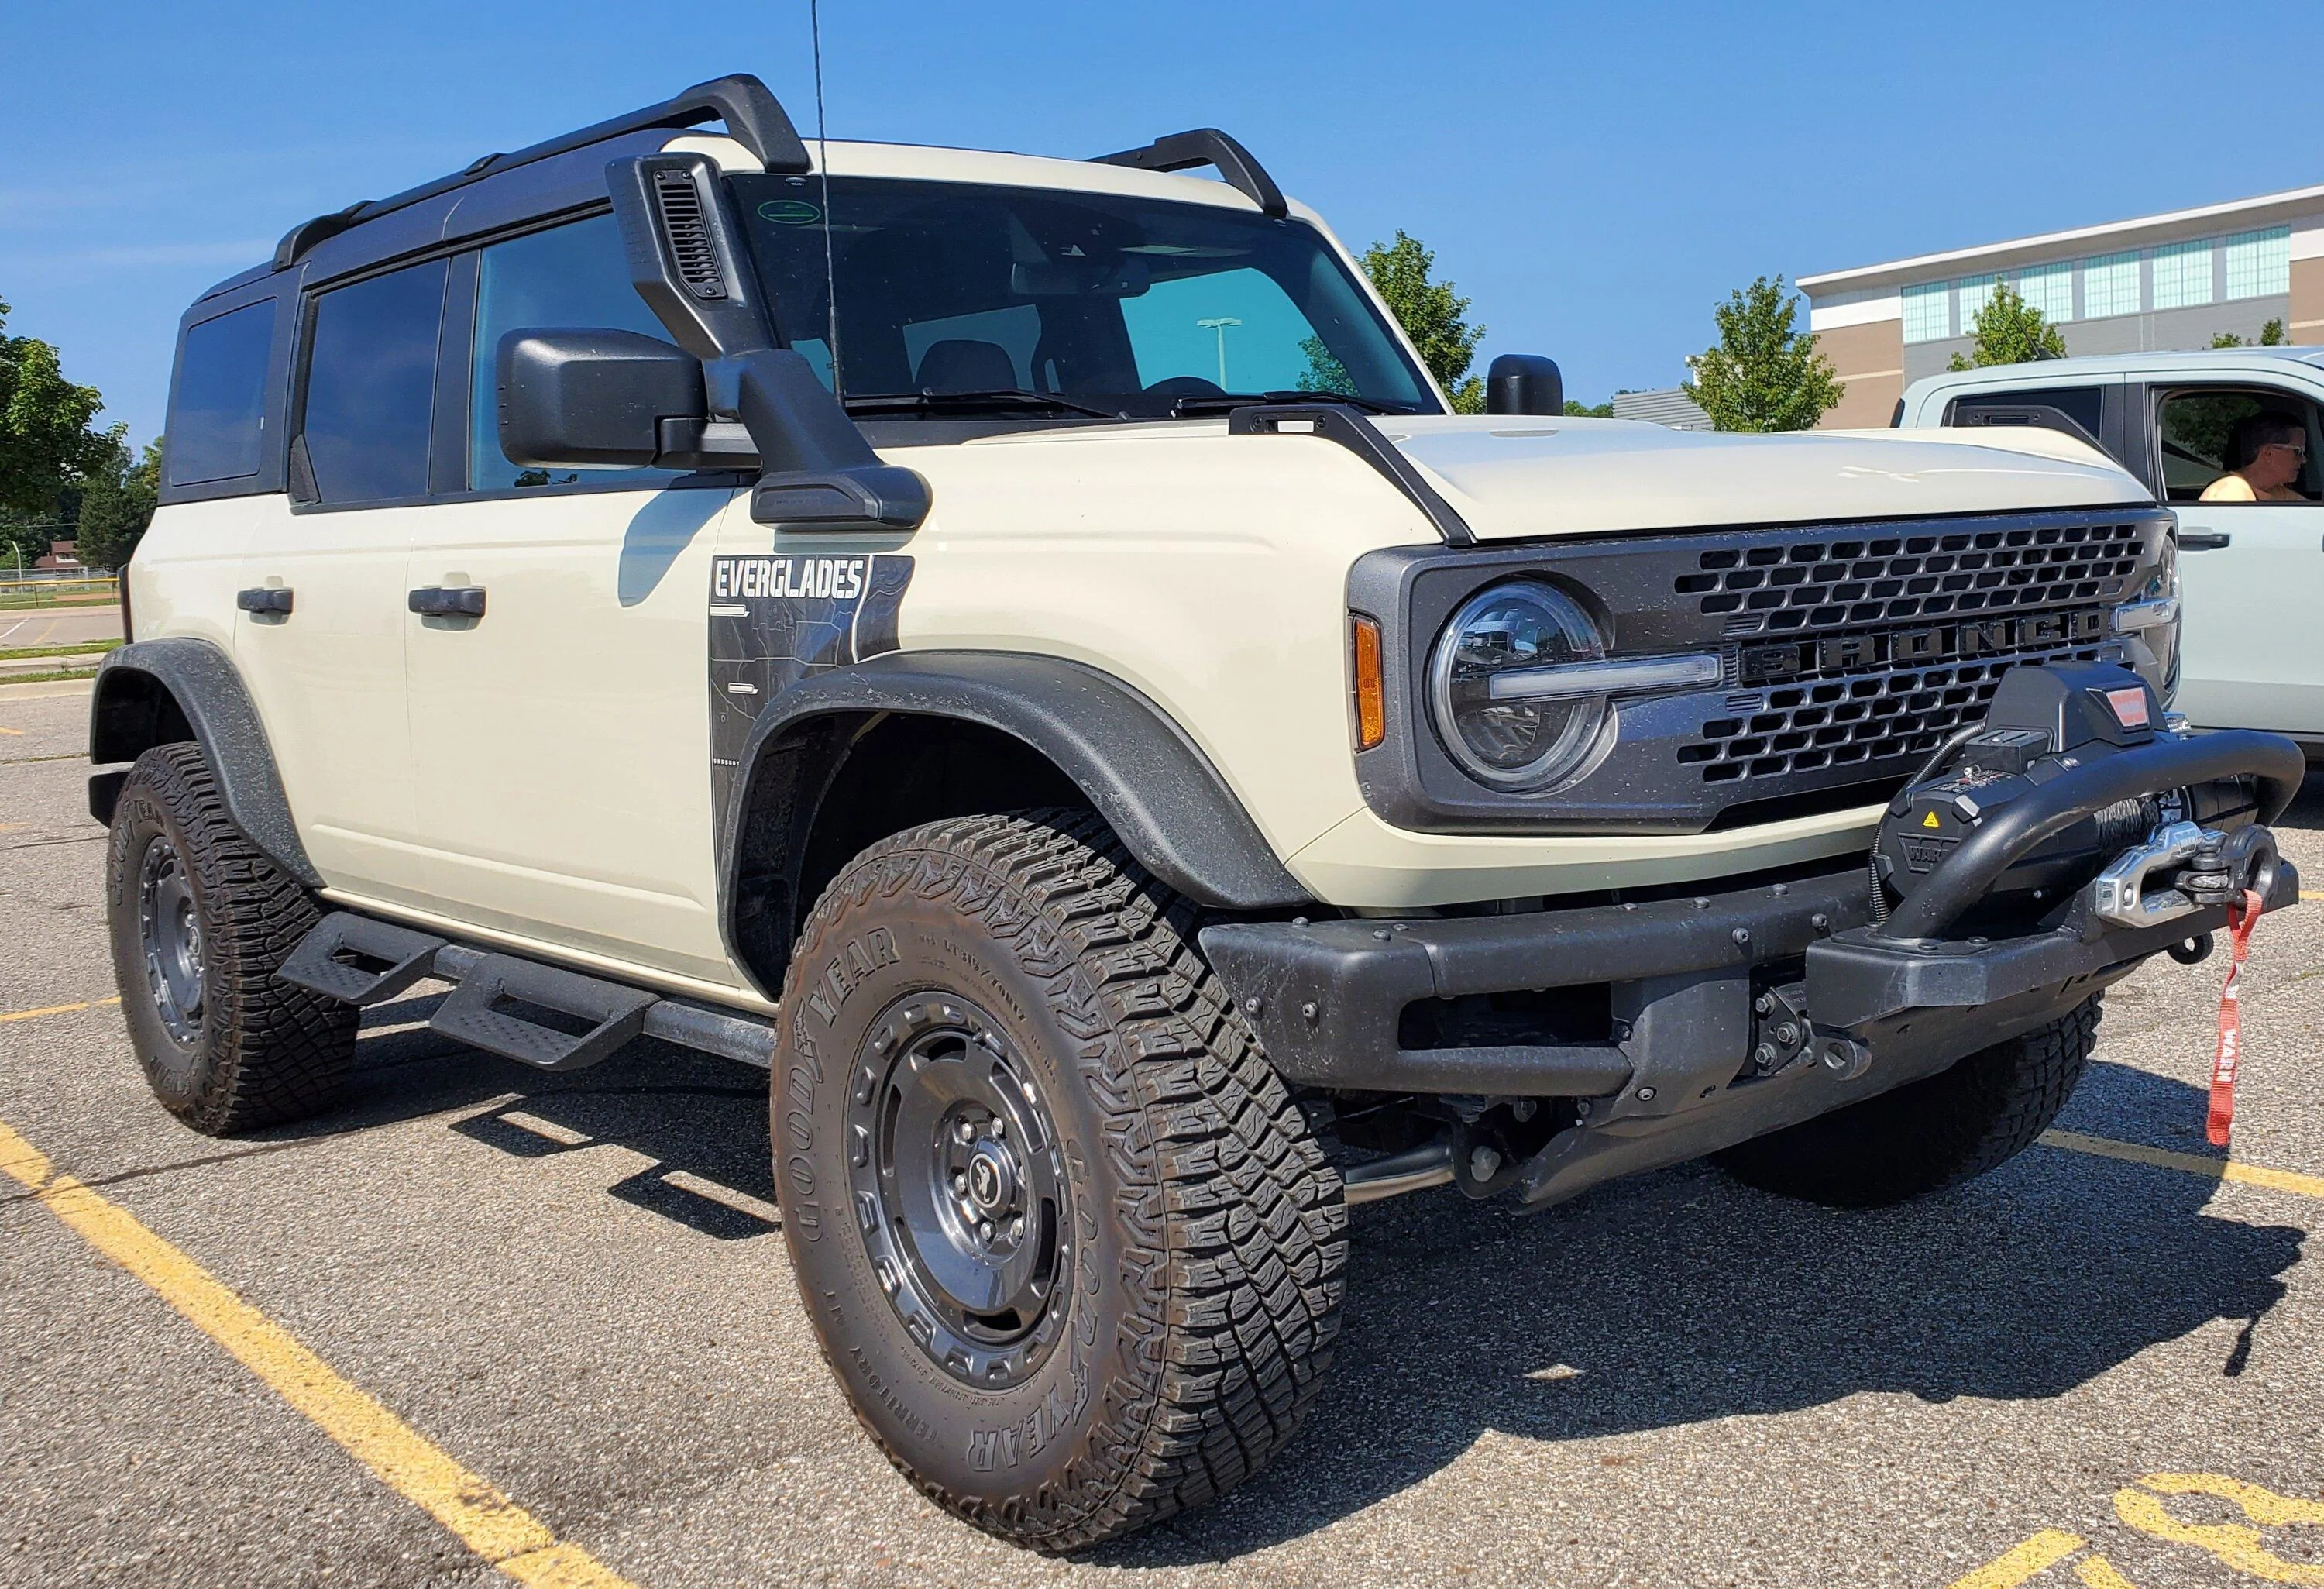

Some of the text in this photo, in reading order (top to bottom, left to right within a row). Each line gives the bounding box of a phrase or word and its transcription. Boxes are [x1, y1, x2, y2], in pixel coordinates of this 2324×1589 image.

[716, 559, 865, 599] EVERGLADES
[1739, 610, 2111, 683] BRONCO
[2216, 1027, 2237, 1083] WARN
[849, 1345, 939, 1442] TERRITORY
